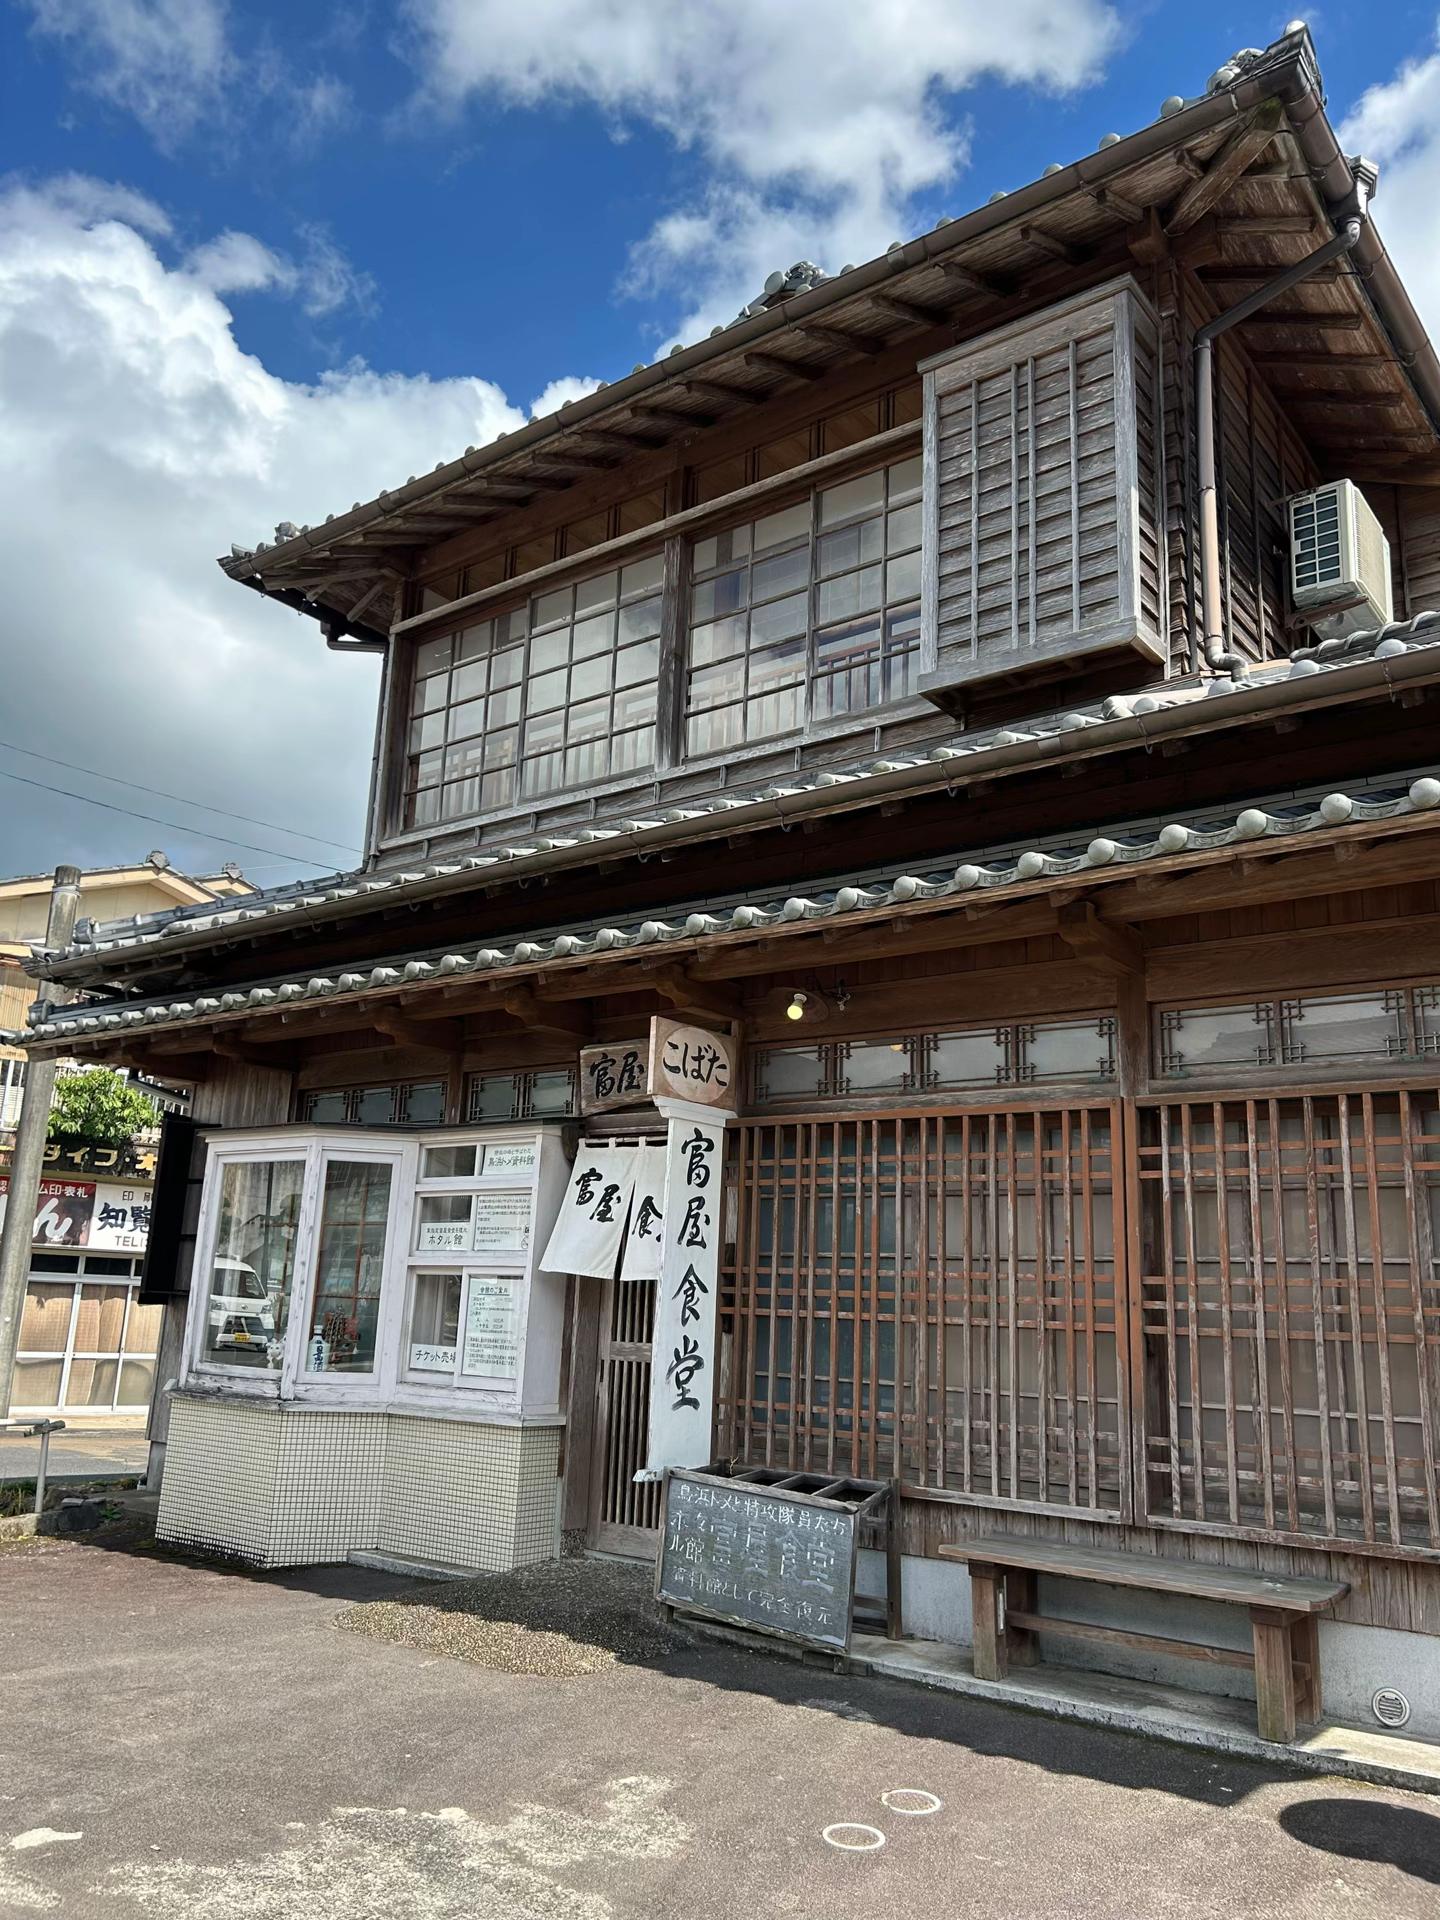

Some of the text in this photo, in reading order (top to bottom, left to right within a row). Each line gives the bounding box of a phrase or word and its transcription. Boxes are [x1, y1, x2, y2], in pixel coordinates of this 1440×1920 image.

[588, 1051, 645, 1099] 富屋
[662, 1040, 729, 1087] こばた
[428, 1233, 463, 1246] ホタル館
[665, 1127, 715, 1412] 富屋食堂
